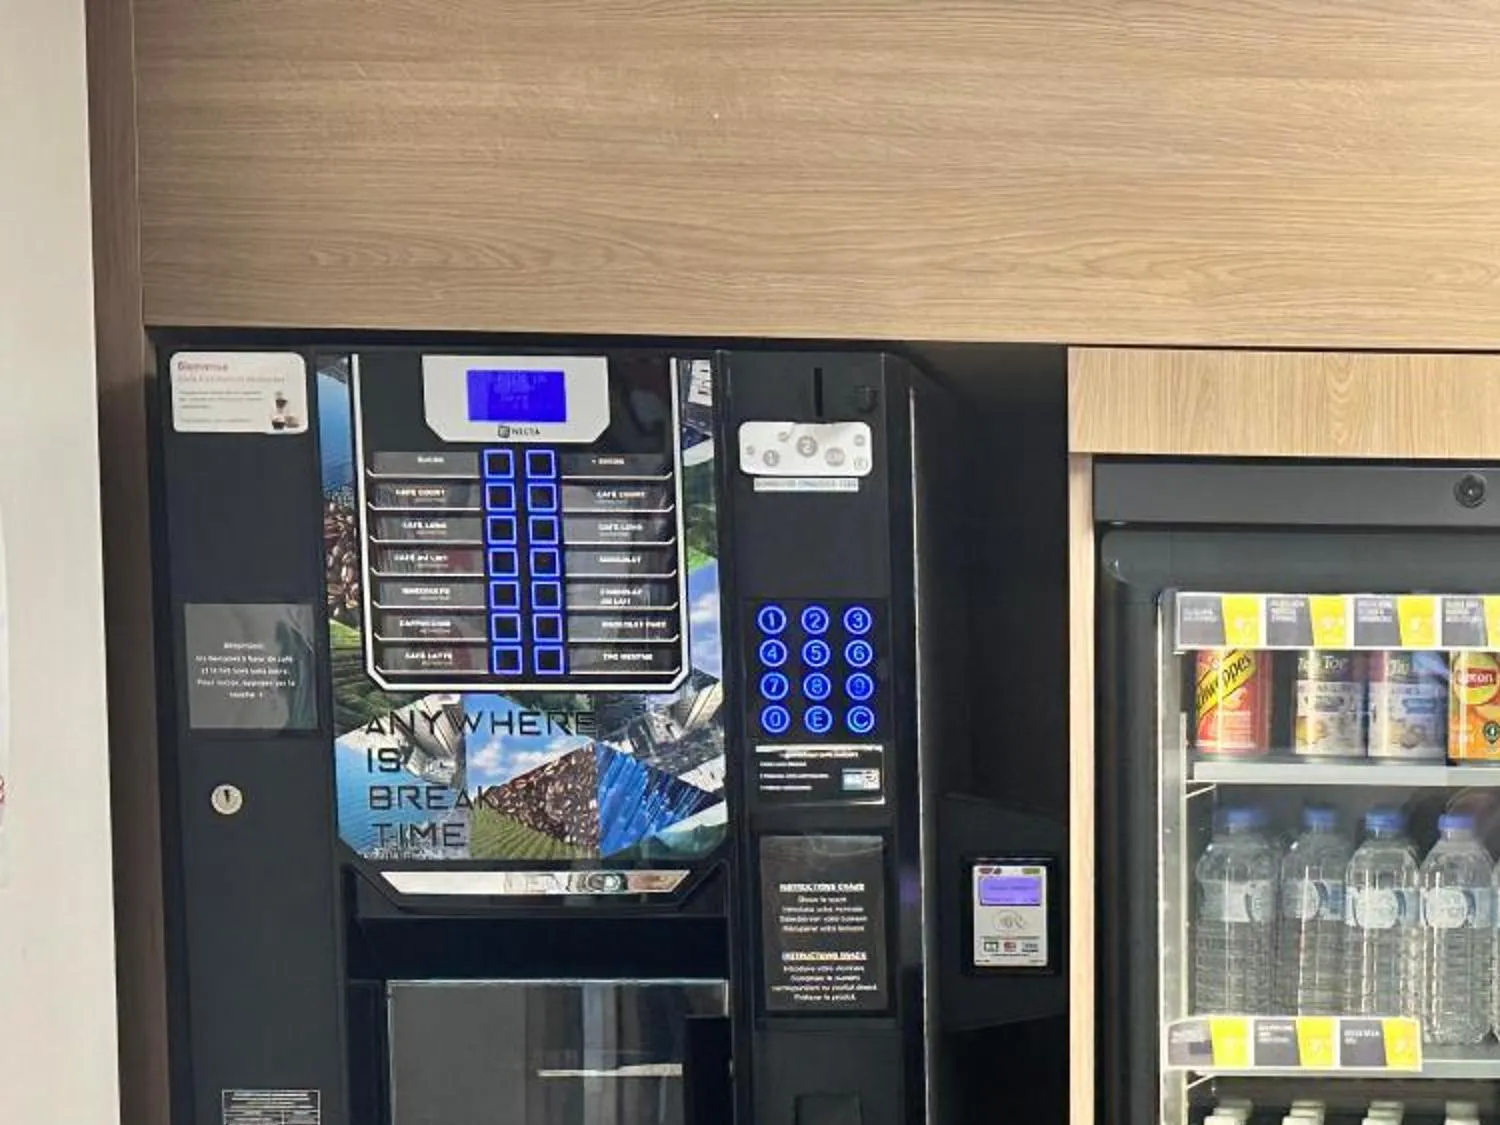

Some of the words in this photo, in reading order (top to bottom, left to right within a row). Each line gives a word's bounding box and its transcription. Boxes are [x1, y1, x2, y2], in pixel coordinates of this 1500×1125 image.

[767, 612, 776, 628] 1
[809, 612, 820, 629] 2
[852, 613, 863, 629] 3
[767, 646, 778, 661] 4
[811, 645, 821, 661] 5
[853, 646, 865, 661] 6
[769, 679, 779, 694] 7
[811, 679, 822, 694] 8
[854, 679, 865, 694] 9
[365, 711, 598, 735] ANYWHERE
[813, 711, 824, 726] E
[853, 711, 868, 727] C
[367, 747, 400, 773] IS
[368, 785, 501, 811] BREAK
[371, 822, 465, 847] TIME
